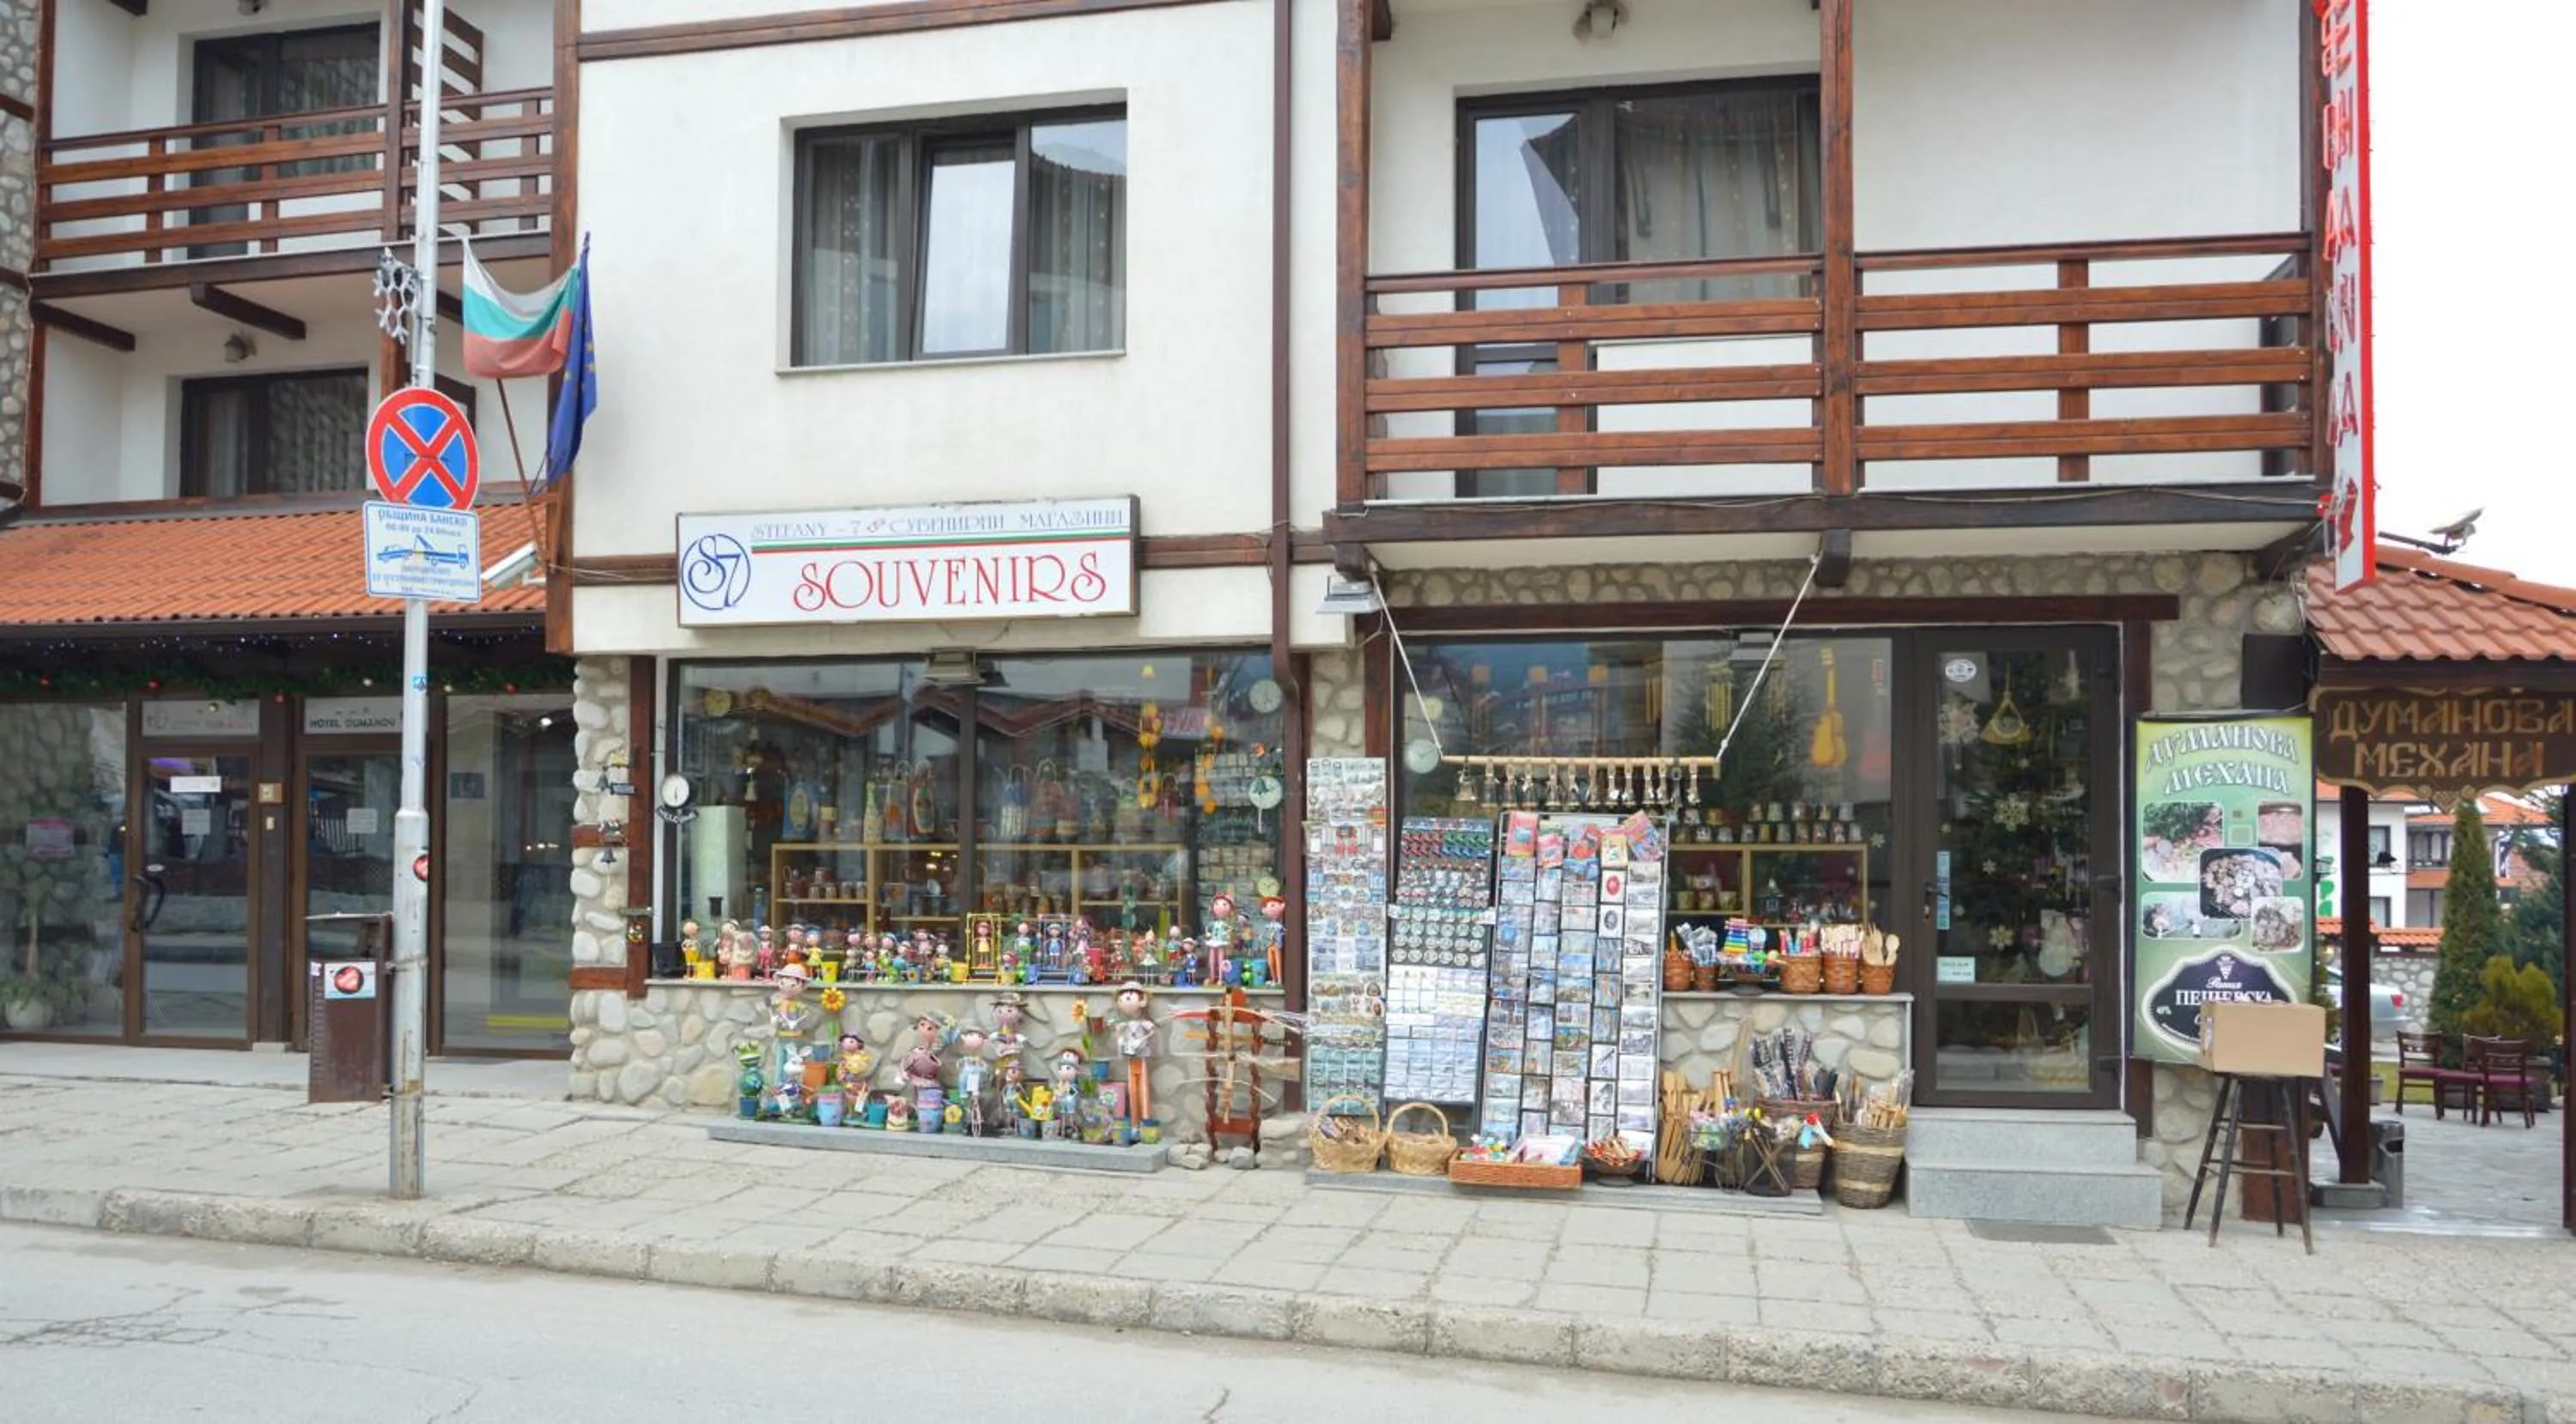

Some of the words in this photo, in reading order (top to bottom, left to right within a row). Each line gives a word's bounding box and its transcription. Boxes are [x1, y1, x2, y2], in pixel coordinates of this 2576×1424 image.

[793, 551, 1108, 612] SOUVENIRS
[2329, 698, 2576, 743] ДУМАНОВА
[2146, 724, 2299, 773] ДУМАНОВА
[2354, 741, 2544, 777] МЕХАНА
[2163, 761, 2290, 795] МЕХАНА
